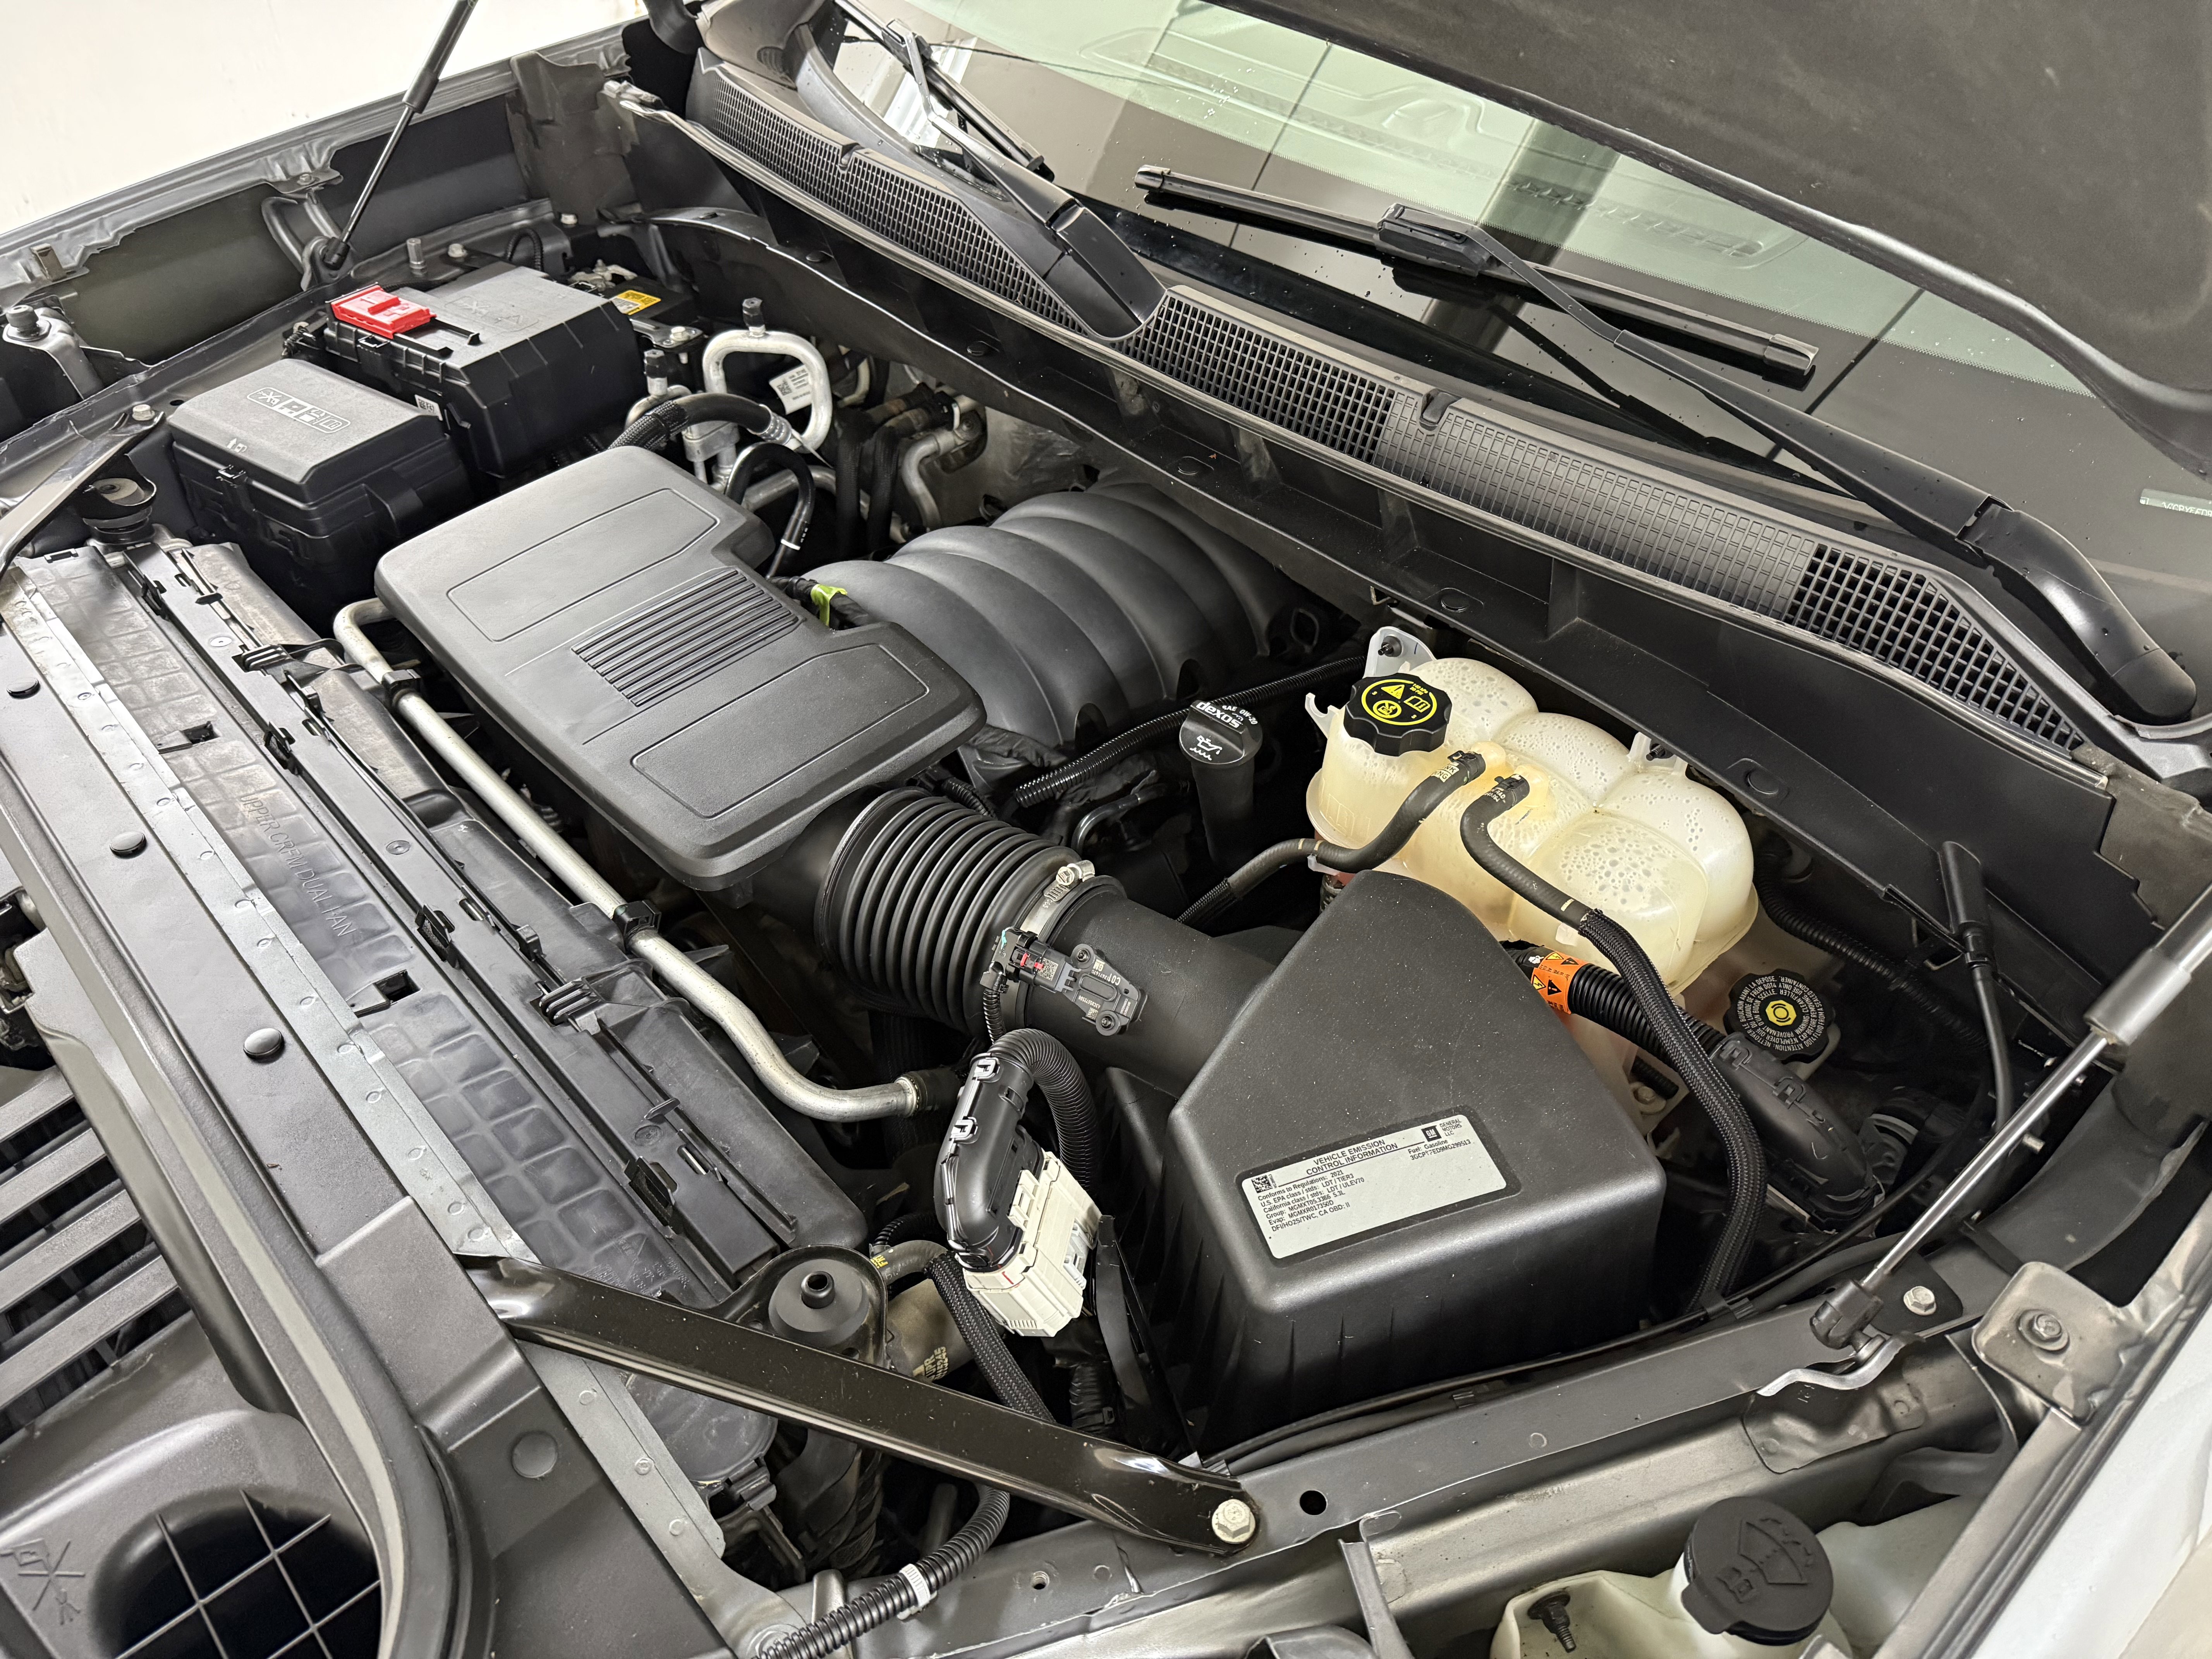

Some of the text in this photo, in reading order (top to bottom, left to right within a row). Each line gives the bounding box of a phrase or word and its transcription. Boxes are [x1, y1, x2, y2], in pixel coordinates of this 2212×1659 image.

[1196, 702, 1242, 728] dexos
[240, 795, 280, 833] UPPER
[1093, 960, 1104, 972] GM
[1779, 976, 1809, 993] CONTAINER.
[1739, 986, 1751, 1000] AVANT
[1750, 986, 1764, 998] FREIN
[1779, 989, 1798, 1000] FILLER
[1807, 991, 1822, 1007] SEALED
[1737, 1000, 1746, 1022] BOUCHON
[1745, 1003, 1753, 1020] LIQUIDE
[1752, 999, 1762, 1013] BIDON
[1779, 982, 1817, 1041] CAP BEFORE REMOVING. USE ONLY
[1796, 998, 1809, 1013] CLEAN
[1755, 1027, 1766, 1037] QUE
[1762, 1025, 1794, 1037] PROVENANT
[1813, 1025, 1824, 1039] FLUID
[1747, 1029, 1771, 1048] NETTOYER
[1773, 1043, 1803, 1051] ATTENTION:
[1439, 1118, 1462, 1128] GENERAL
[1442, 1123, 1462, 1132] MOTORS
[1424, 1140, 1448, 1149] Gasoline
[1306, 1143, 1398, 1175] CONTROL INFORMATION
[1313, 1139, 1386, 1166] VEHICLE EMISSION
[1258, 1188, 1286, 1201] Conforms
[1293, 1176, 1328, 1190] Regulations:
[1330, 1170, 1344, 1178] 2021
[1286, 1191, 1301, 1199] class
[1305, 1185, 1320, 1194] stds:
[1336, 1173, 1354, 1183] TIER3
[1263, 1201, 1291, 1213] California
[1291, 1195, 1306, 1204] class
[1310, 1190, 1325, 1198] stds:
[1327, 1185, 1338, 1193] LDT
[1343, 1177, 1365, 1188] ULEV70
[1266, 1208, 1287, 1220] Group:
[1318, 1208, 1328, 1216] CA
[1329, 1204, 1345, 1213] OBD:
[1268, 1217, 1286, 1226] Evap:
